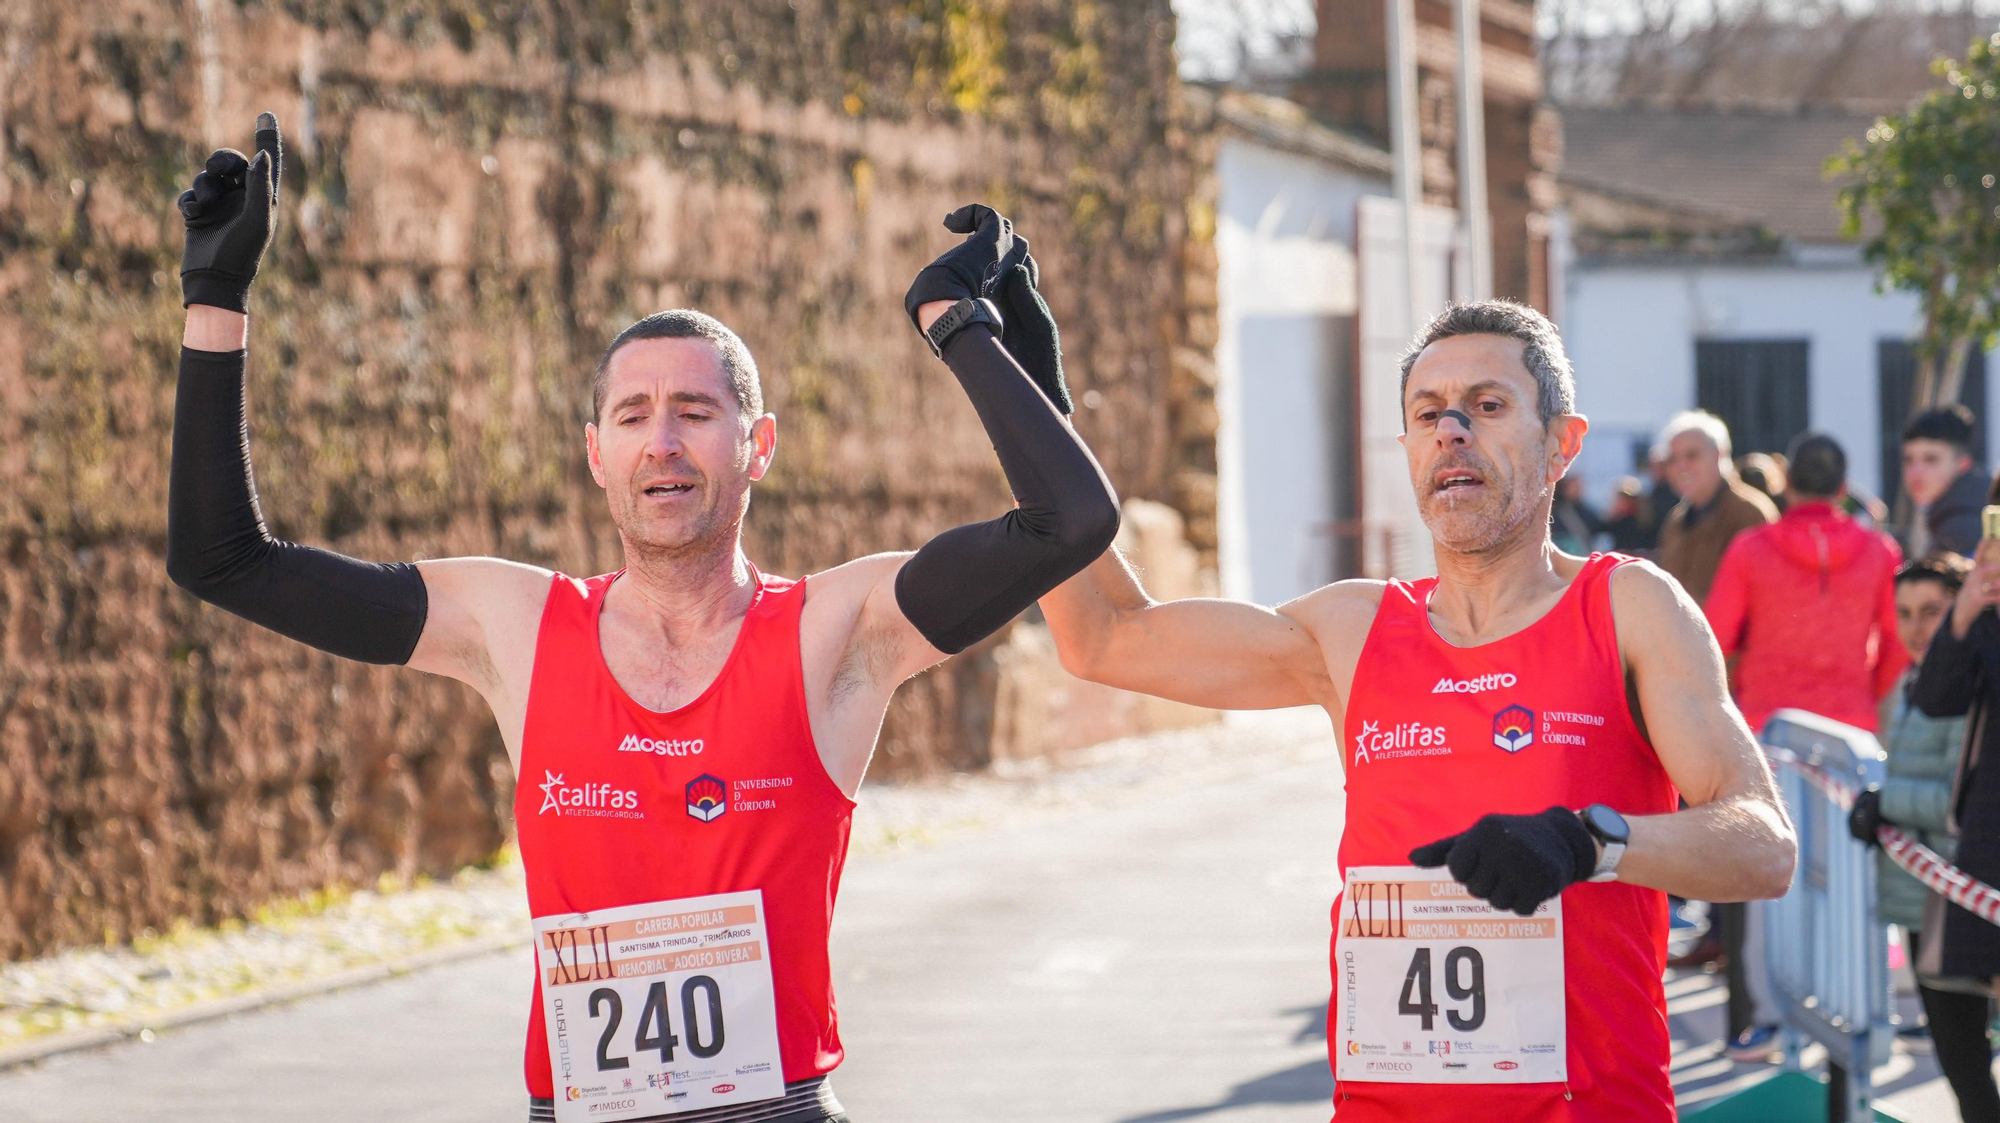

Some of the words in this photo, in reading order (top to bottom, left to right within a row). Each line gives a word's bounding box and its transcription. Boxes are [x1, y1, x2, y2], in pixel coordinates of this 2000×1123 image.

[1431, 672, 1517, 694] Mosttro
[1543, 711, 1604, 727] UNIVERSIDAD
[617, 733, 704, 757] Mosttro
[1371, 721, 1446, 752] califas
[1542, 730, 1585, 746] CÓRDOBA
[733, 777, 793, 791] UNIVERSIDAD
[558, 782, 638, 809] califas
[734, 799, 776, 812] CÓRDOBA
[1430, 882, 1470, 897] CARRER
[1345, 882, 1406, 938] XLII
[1413, 905, 1454, 914] SANTISIMA
[1455, 905, 1492, 914] TRINIDAD
[635, 914, 680, 935] CARRERA
[682, 910, 725, 927] POPULAR
[1408, 924, 1459, 938] MEMORIAL
[619, 941, 660, 954] SANTISIMA
[662, 936, 698, 948] TRINIDAD
[704, 928, 751, 943] TRINITARIOS
[547, 925, 617, 986] XLII
[617, 957, 668, 977] MEMORIAL
[1398, 946, 1486, 1032] 49
[588, 975, 725, 1072] 240
[1454, 1040, 1474, 1050] fest
[1376, 1062, 1412, 1071] IMDECO
[599, 1099, 636, 1112] IMDECO
